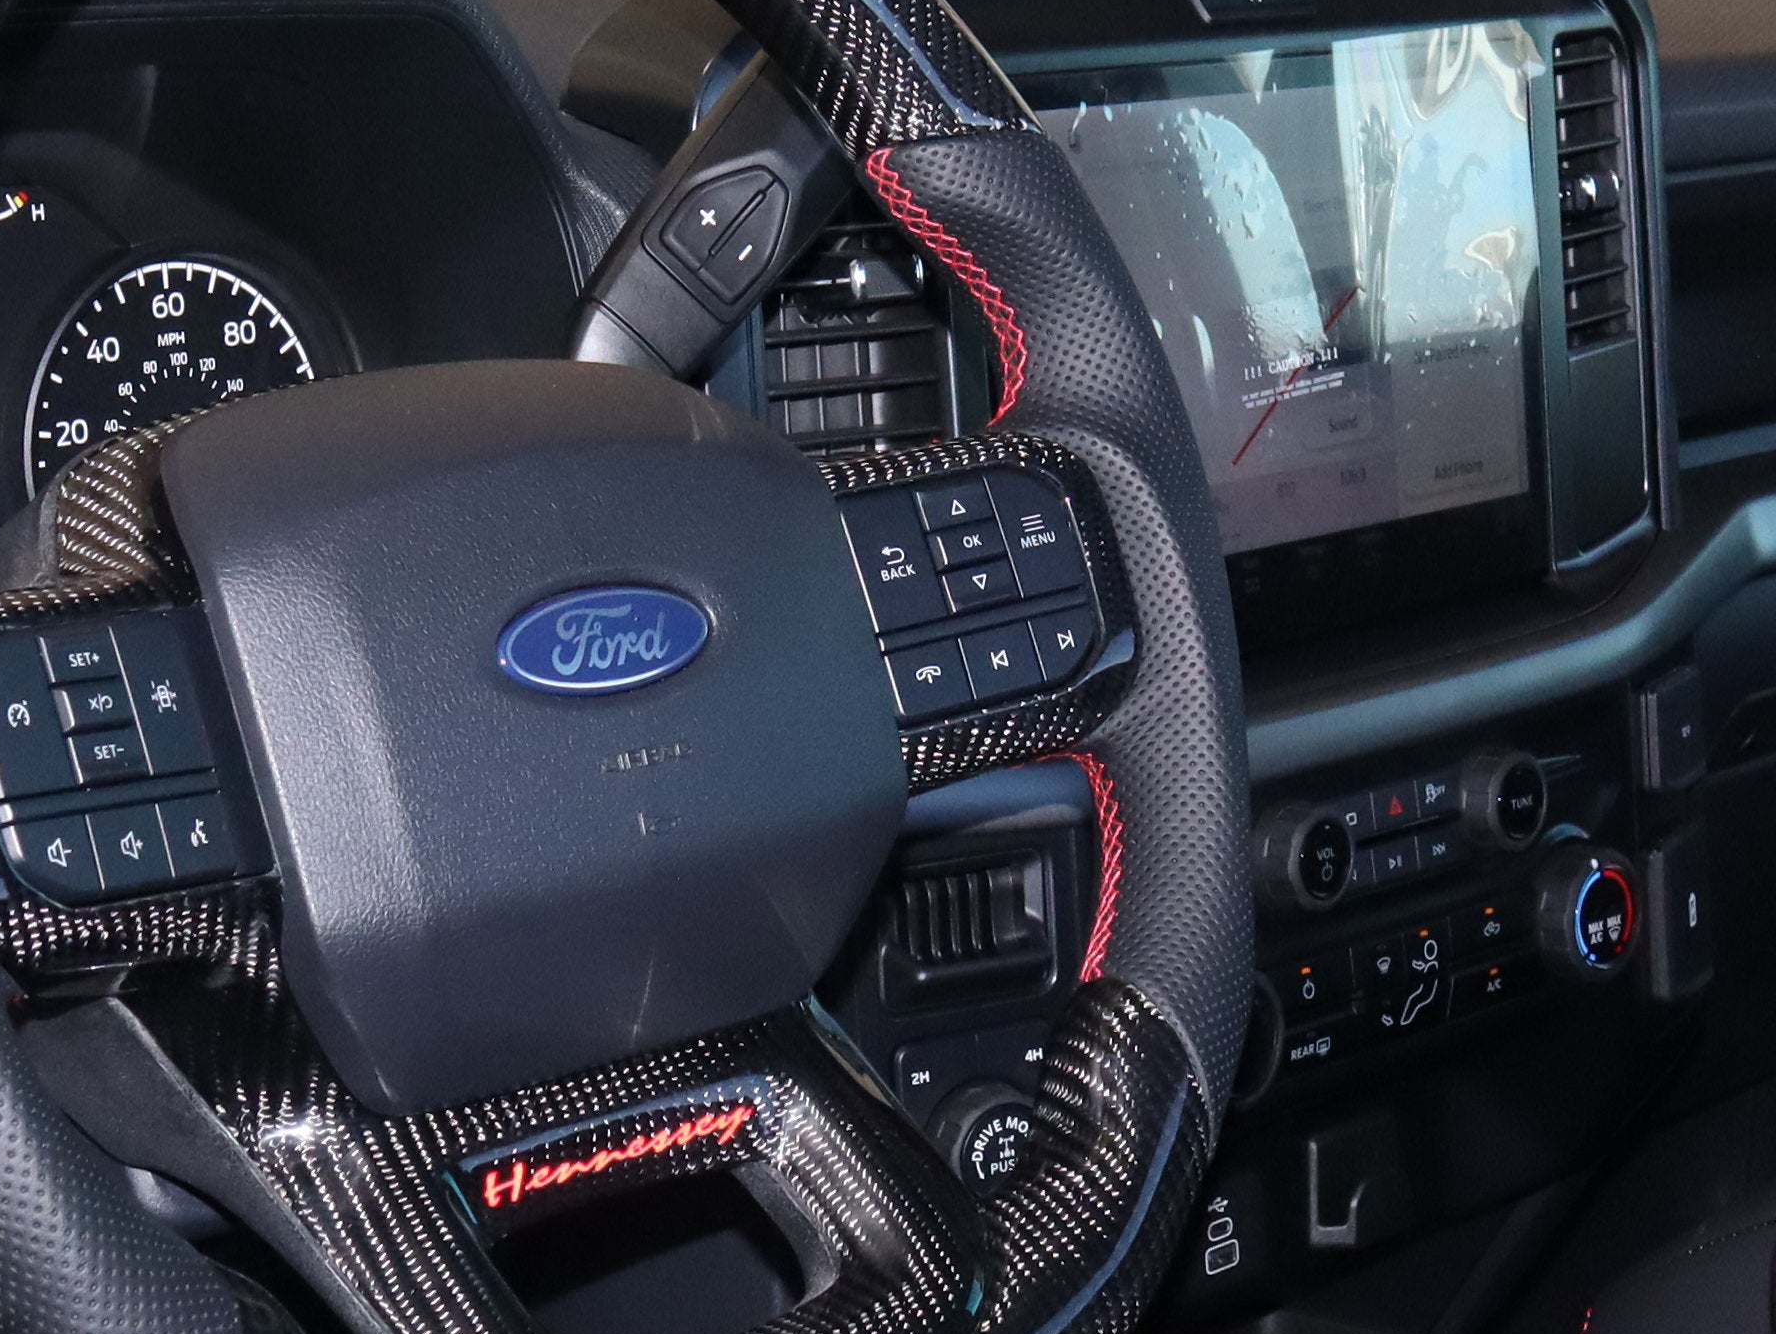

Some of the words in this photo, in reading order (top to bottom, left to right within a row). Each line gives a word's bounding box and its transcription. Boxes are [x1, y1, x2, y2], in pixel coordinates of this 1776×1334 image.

[30, 203, 46, 223] H
[151, 291, 185, 319] 60
[157, 331, 186, 348] MPH
[224, 319, 257, 347] 80
[86, 336, 121, 364] 40
[142, 360, 158, 375] 80
[168, 351, 189, 367] 100
[198, 357, 216, 372] 120
[117, 382, 133, 397] 60
[226, 378, 245, 393] 140
[55, 418, 89, 448] 20
[103, 419, 119, 434] 40
[962, 534, 983, 550] OK
[1019, 531, 1057, 550] MENU
[880, 563, 916, 584] BACK
[551, 603, 672, 677] Ford
[1509, 794, 1534, 811] TUNE
[1316, 846, 1336, 862] VOL
[1025, 1047, 1044, 1062] 4H
[1290, 1042, 1315, 1062] REAR
[910, 1070, 931, 1086] 2H
[971, 1118, 1004, 1163] DRIVE
[1005, 1116, 1029, 1138] MO
[483, 1103, 756, 1209] Hennessey
[990, 1157, 1019, 1175] PUS
